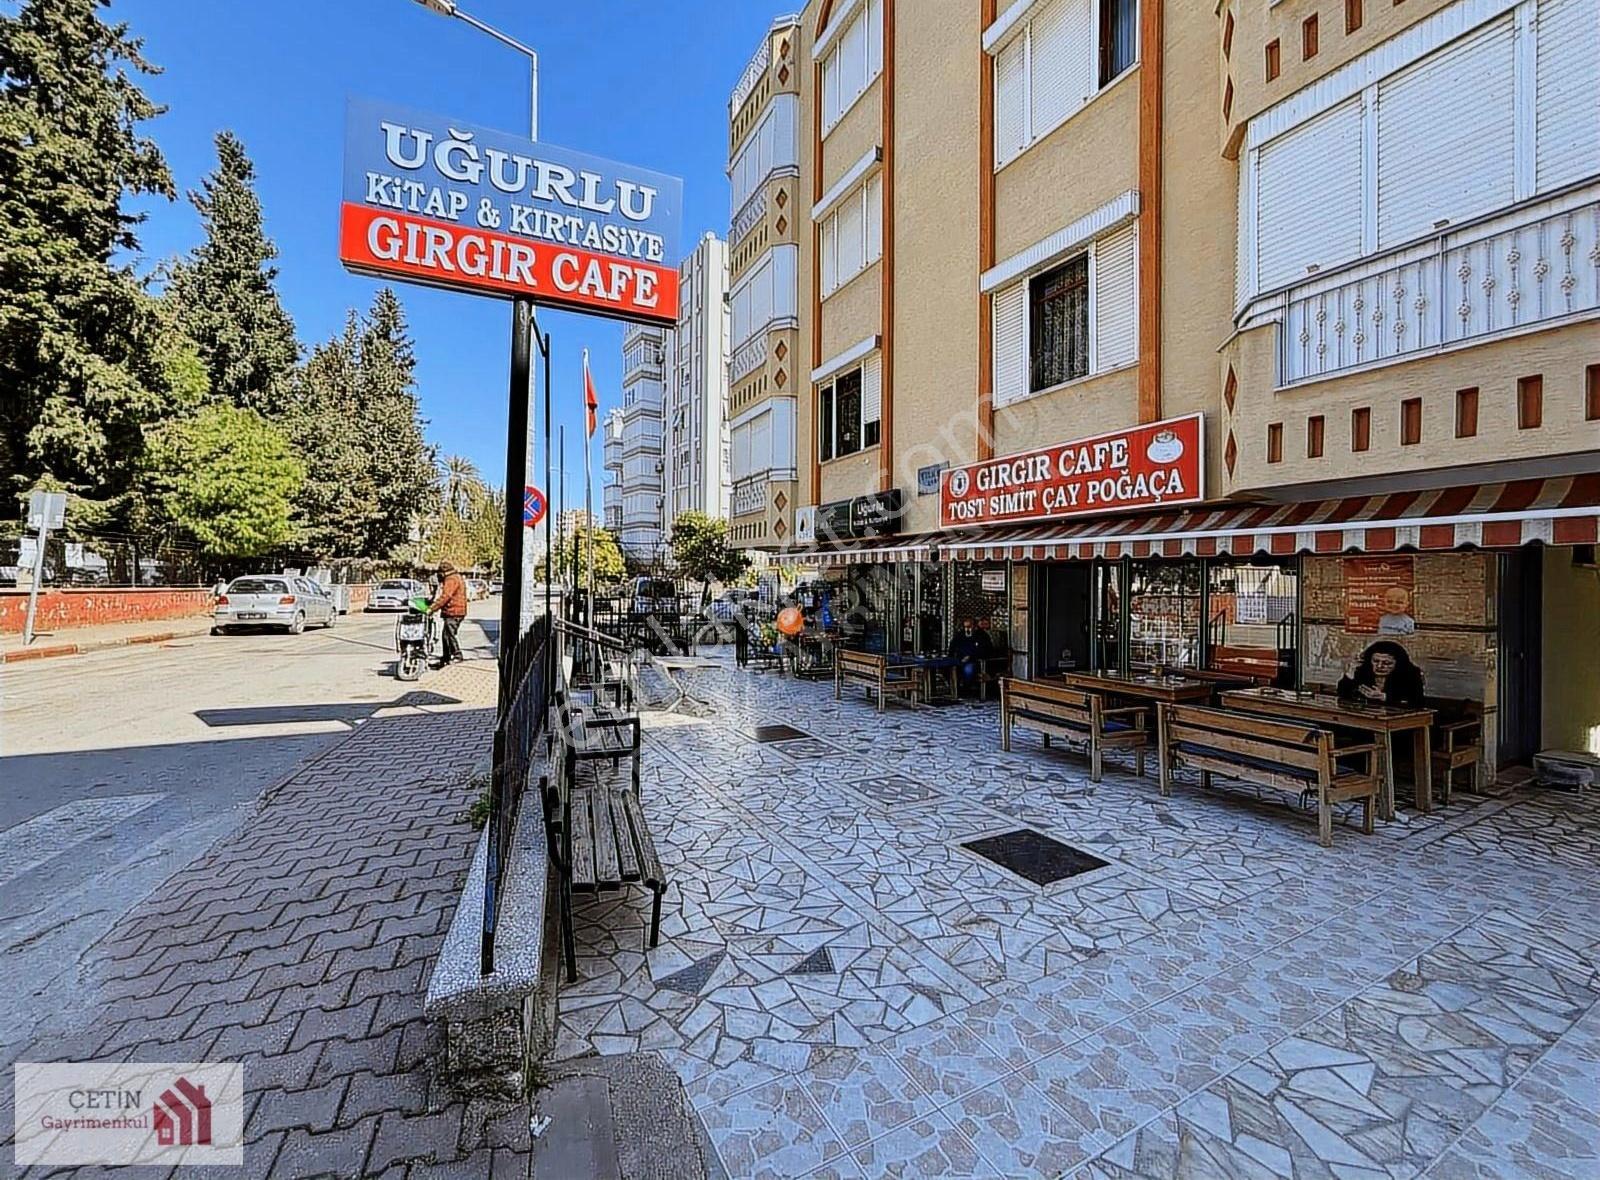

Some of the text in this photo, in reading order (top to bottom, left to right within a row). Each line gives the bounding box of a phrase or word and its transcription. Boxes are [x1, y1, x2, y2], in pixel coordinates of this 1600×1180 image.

[381, 121, 657, 221] UĞURLU
[477, 198, 501, 229] &
[368, 217, 659, 308] GIRGIR CAFE
[976, 455, 1051, 492] GIRGIR
[1059, 439, 1129, 477] CAFE
[949, 468, 1184, 521] TOST SİMİT ÇAY POĞAÇA
